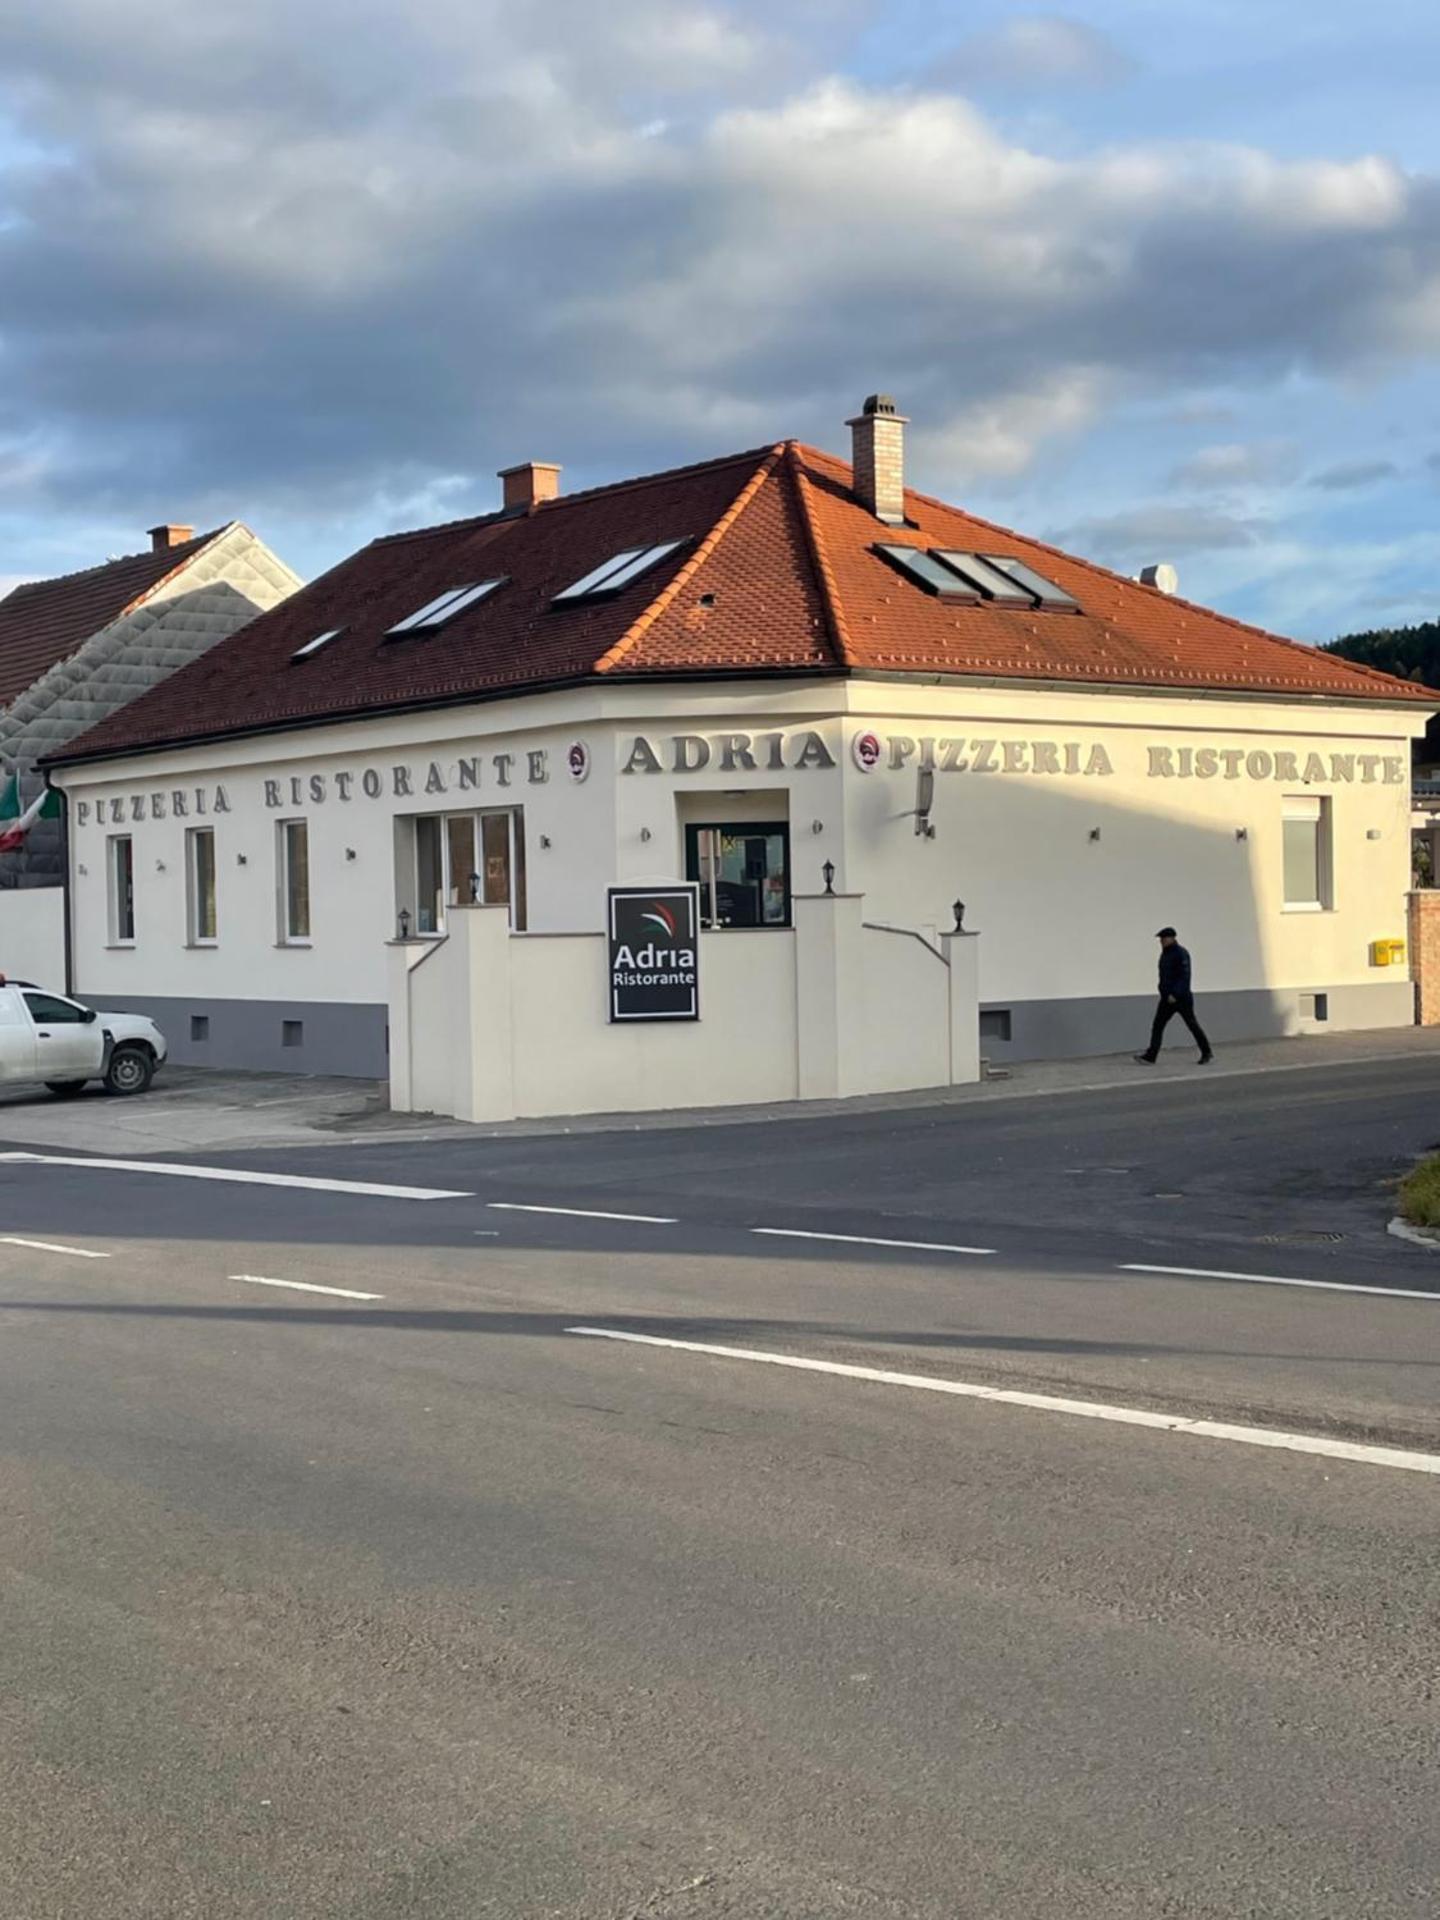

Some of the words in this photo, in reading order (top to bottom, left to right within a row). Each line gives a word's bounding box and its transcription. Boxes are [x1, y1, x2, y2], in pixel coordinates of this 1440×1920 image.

[621, 731, 837, 774] ADRIA
[886, 736, 1114, 775] PIZZERIA
[1146, 746, 1406, 784] RISTORANTE
[77, 785, 232, 827] PIZZERIA
[264, 750, 549, 807] RISTORANTE
[613, 971, 695, 987] Ristorante
